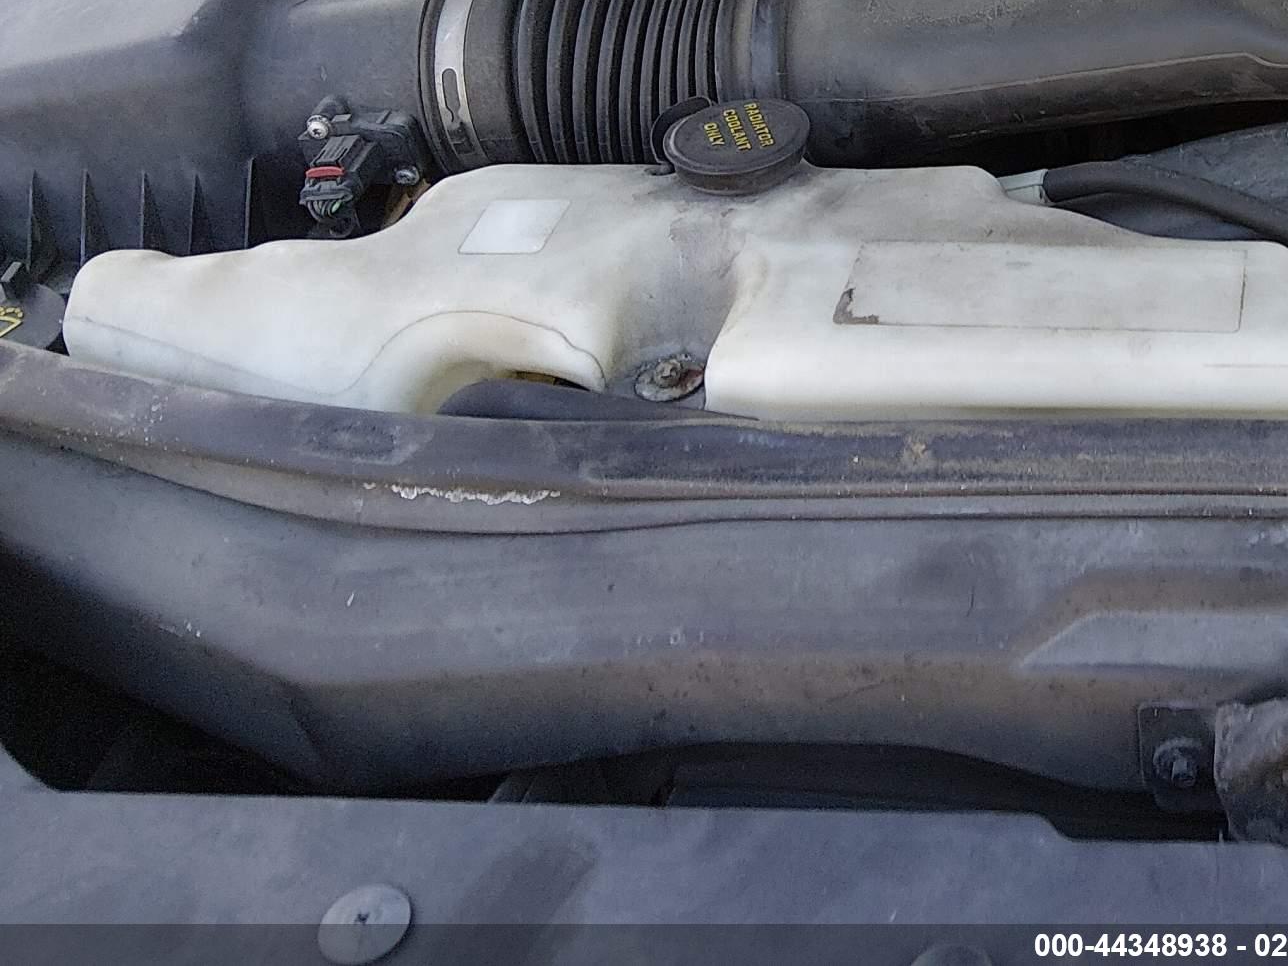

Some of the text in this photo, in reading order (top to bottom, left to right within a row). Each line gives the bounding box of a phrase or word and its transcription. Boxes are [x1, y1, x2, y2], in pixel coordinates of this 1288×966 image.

[704, 122, 725, 146] ONLY
[723, 109, 752, 151] COOLANT
[744, 102, 774, 148] RADIATOR
